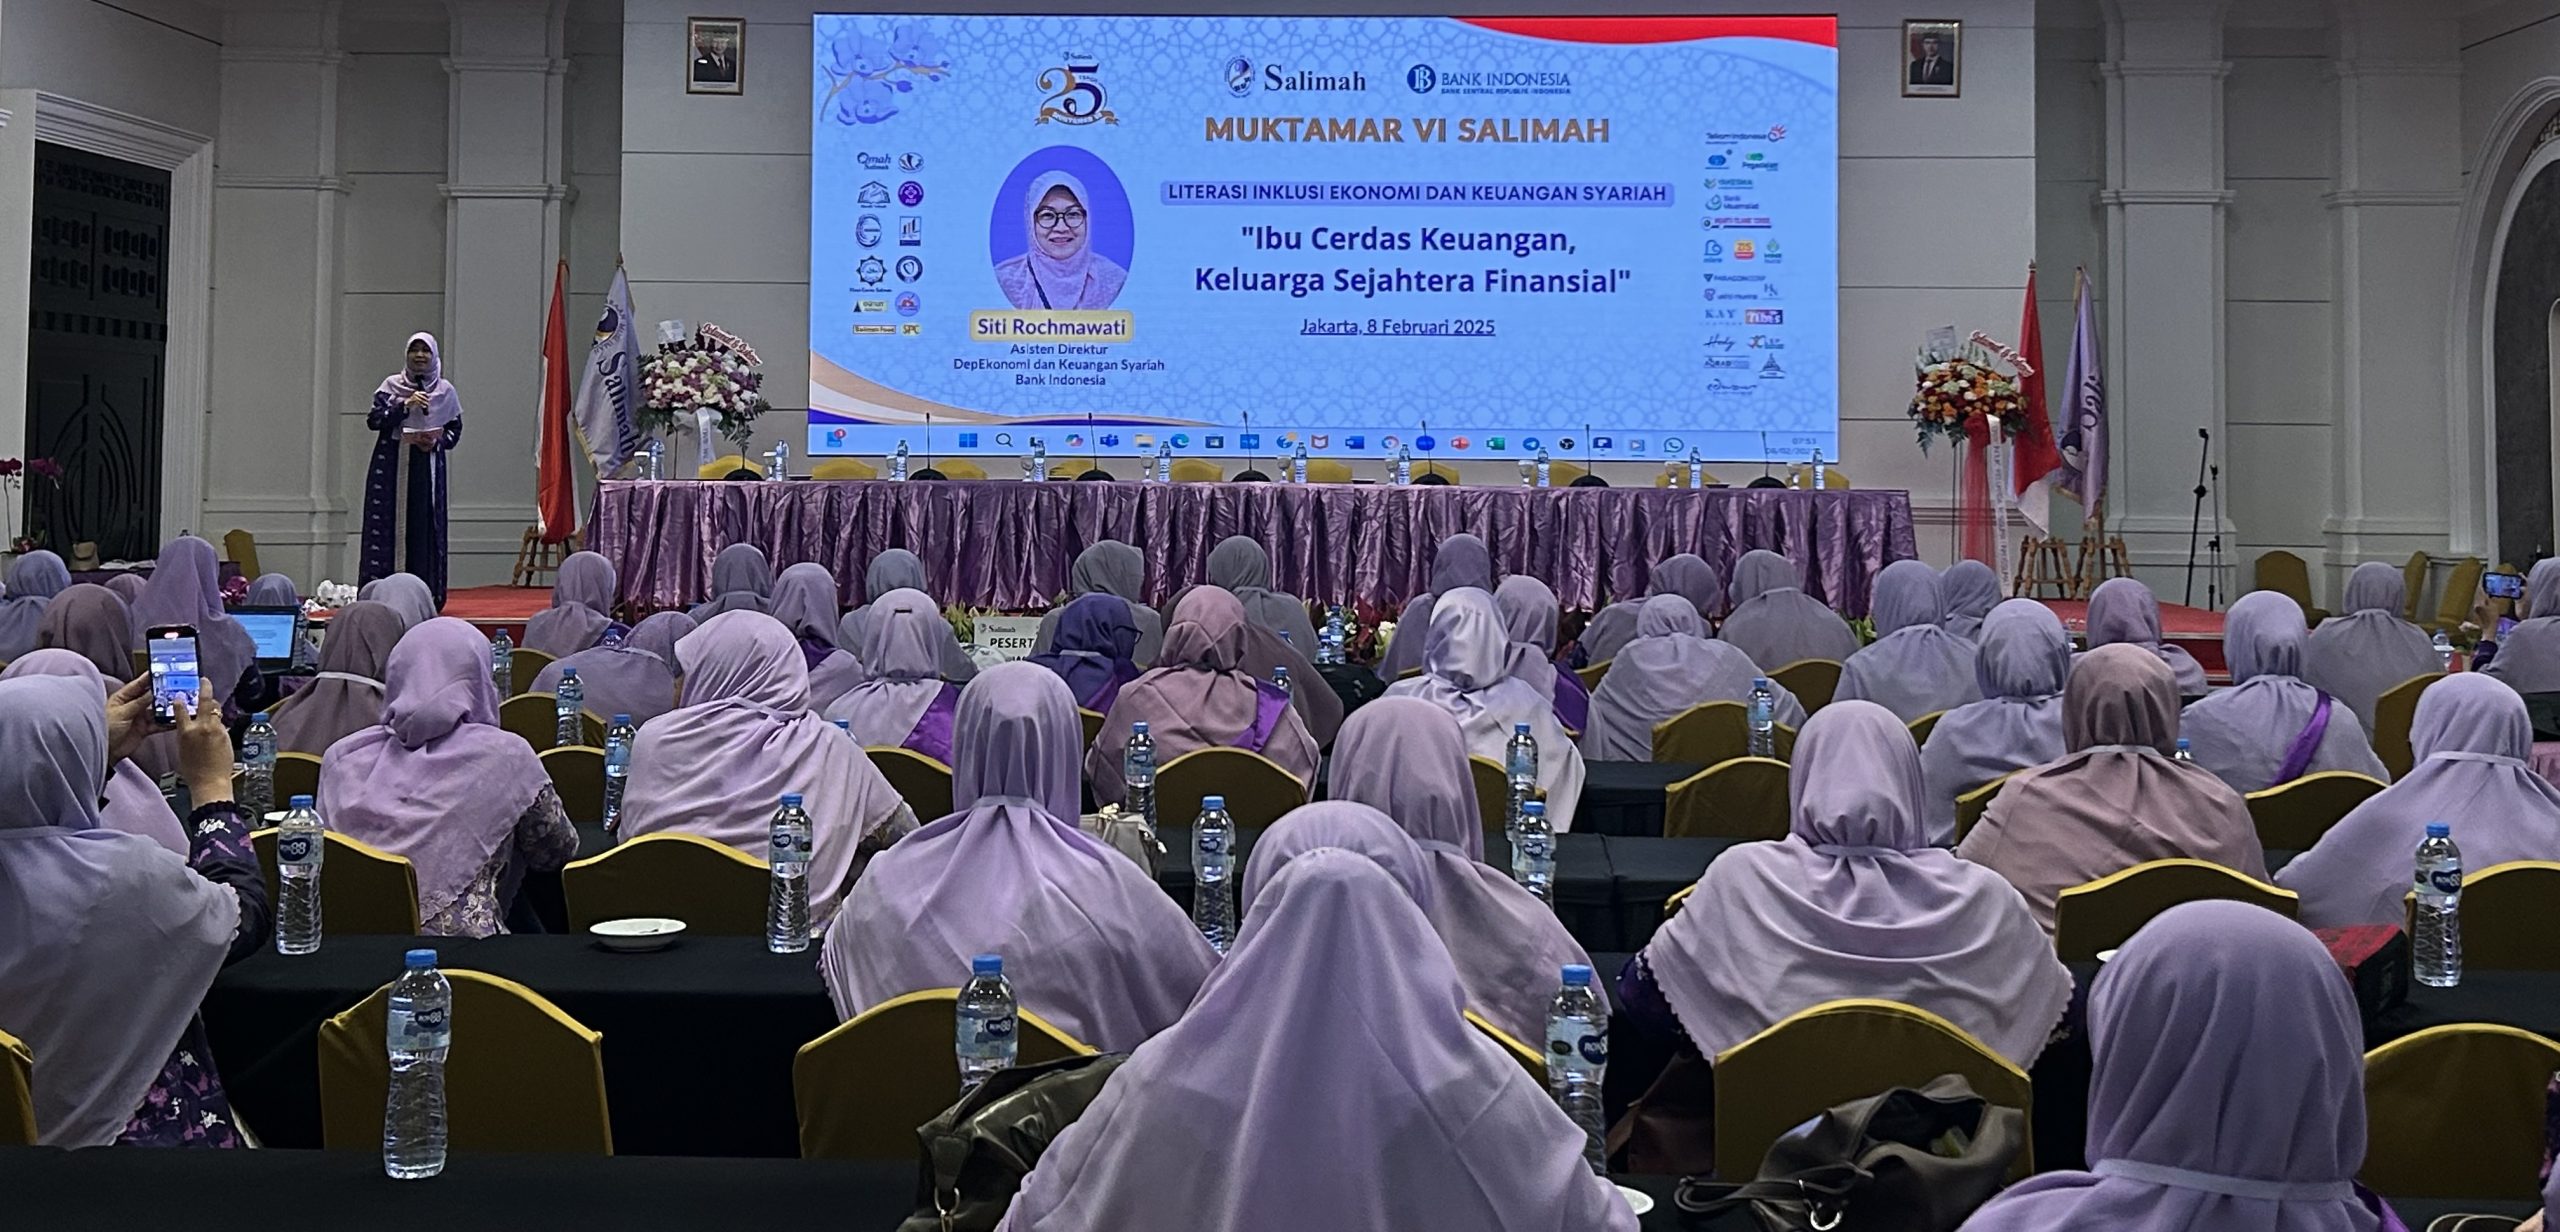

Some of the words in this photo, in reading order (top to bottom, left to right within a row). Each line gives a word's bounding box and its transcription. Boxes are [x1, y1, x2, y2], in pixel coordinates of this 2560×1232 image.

[1264, 64, 1366, 91] Salimah
[1441, 73, 1481, 86] BANK
[1487, 73, 1570, 86] INDONESIA
[1204, 117, 1404, 144] MUKTAMAR
[1412, 118, 1446, 143] VI
[1458, 118, 1609, 144] SALIMAH
[1168, 184, 1247, 200] LITERASI
[1253, 184, 1324, 200] INKLUSI
[1330, 185, 1420, 200] EKONOMI
[1426, 185, 1466, 201] DAN
[1472, 185, 1578, 201] KEUANGAN
[1583, 186, 1666, 201] SYARIAH
[1242, 226, 1301, 250] "Ibu
[1312, 226, 1411, 251] Cerdas
[1421, 227, 1576, 257] Keuangan,
[1196, 267, 1325, 298] Keluarga
[1334, 268, 1475, 298] Sejahtera
[1486, 268, 1631, 293] Finansial"
[978, 318, 1007, 335] Siti
[1013, 318, 1126, 335] Rochmawati
[1301, 318, 1362, 335] Jakarta,
[1368, 319, 1378, 334] 8
[1383, 319, 1449, 334] Februari
[1454, 319, 1495, 334] 2025
[1010, 344, 1054, 355] Asisten
[1058, 344, 1108, 355] Direktur
[954, 359, 1030, 372] DepEkonomi
[1033, 359, 1055, 370] dan
[1059, 359, 1118, 372] Keuangan
[1121, 360, 1165, 373] Syariah
[1015, 374, 1046, 386] Bank
[1050, 374, 1106, 386] Indonesia
[596, 351, 641, 455] Salimah
[990, 637, 1035, 649] PESERT
